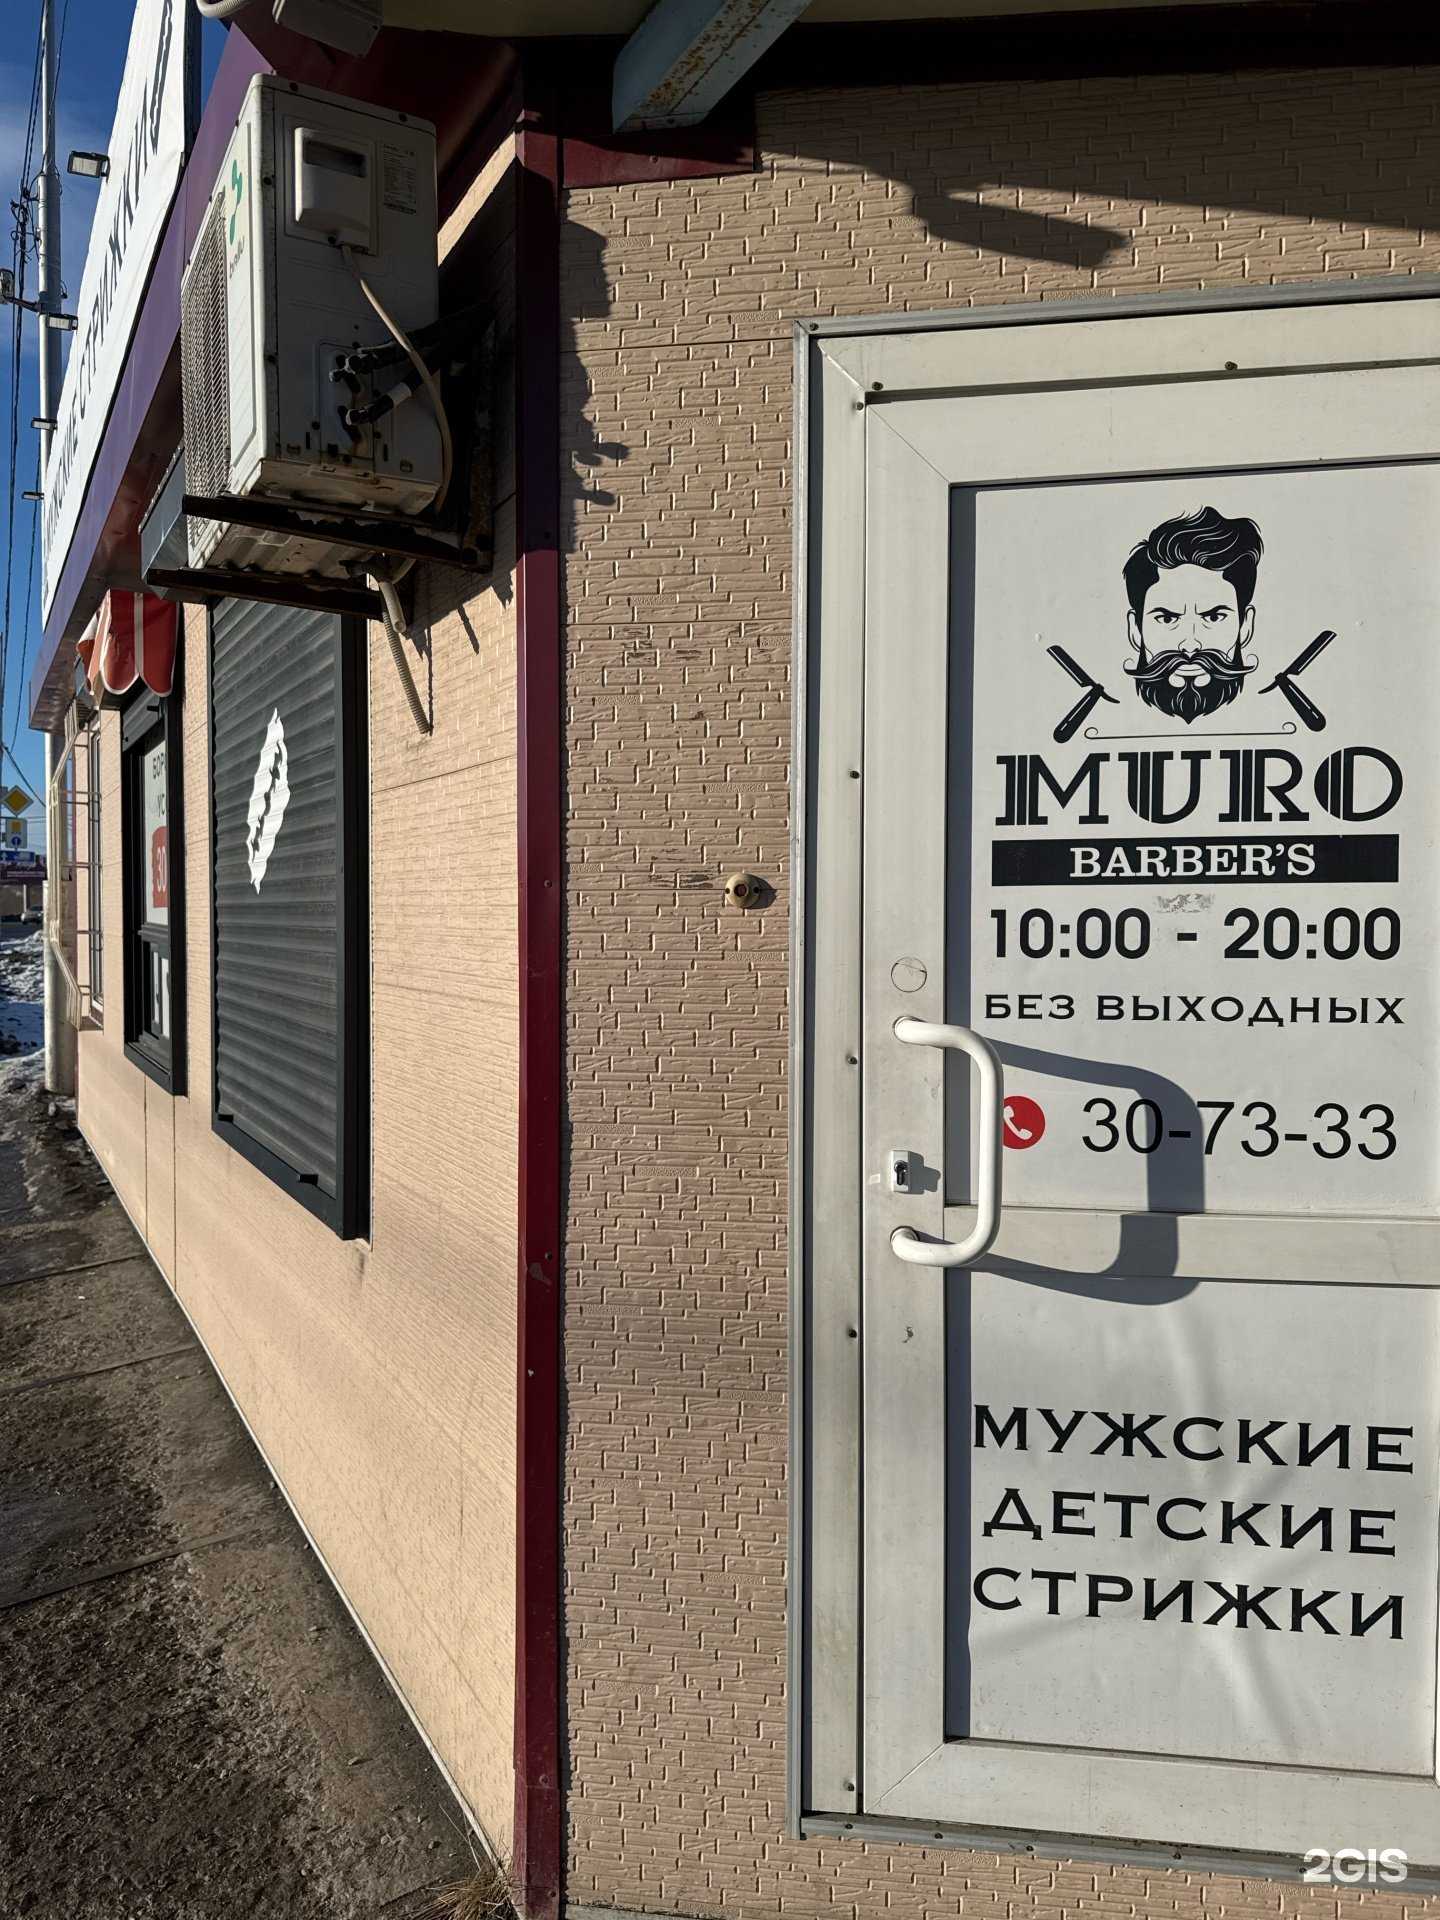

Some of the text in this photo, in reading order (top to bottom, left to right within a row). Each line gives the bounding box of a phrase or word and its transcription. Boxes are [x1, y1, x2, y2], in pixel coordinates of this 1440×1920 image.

[79, 77, 148, 420] СТРИЖКИ
[996, 747, 1403, 825] MURO
[1070, 843, 1316, 878] BARBER'S
[991, 908, 1401, 960] 10:00 - 20:00
[985, 994, 1405, 1027] БЕЗ ВЫХОДНЫХ
[1083, 1098, 1397, 1160] 30-73-33
[974, 1405, 1413, 1474] МУЖСКИЕ
[982, 1488, 1396, 1557] ДЕТСКИЕ
[974, 1567, 1404, 1640] СТРИЖКИ
